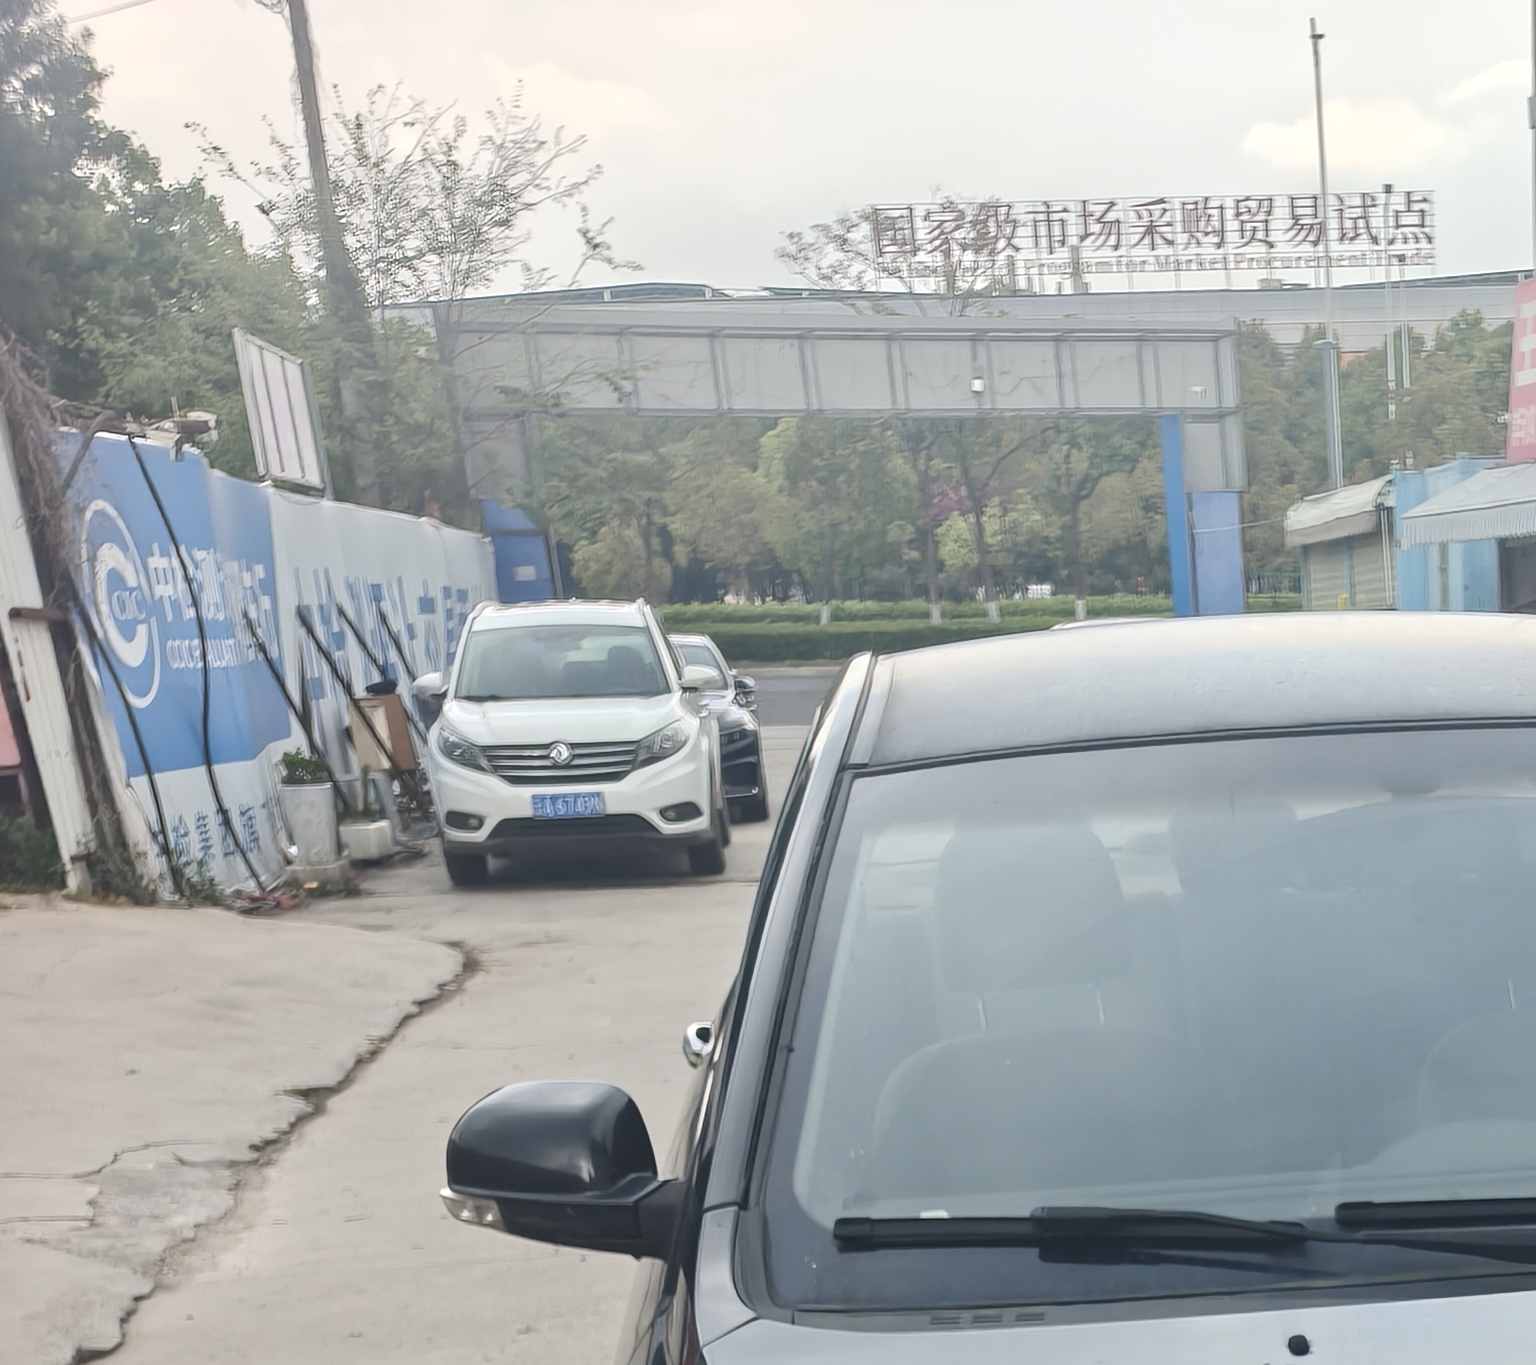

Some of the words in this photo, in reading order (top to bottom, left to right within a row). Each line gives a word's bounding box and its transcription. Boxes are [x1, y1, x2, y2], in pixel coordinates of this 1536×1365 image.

[873, 191, 1434, 256] 国家级市场采购贸易试点
